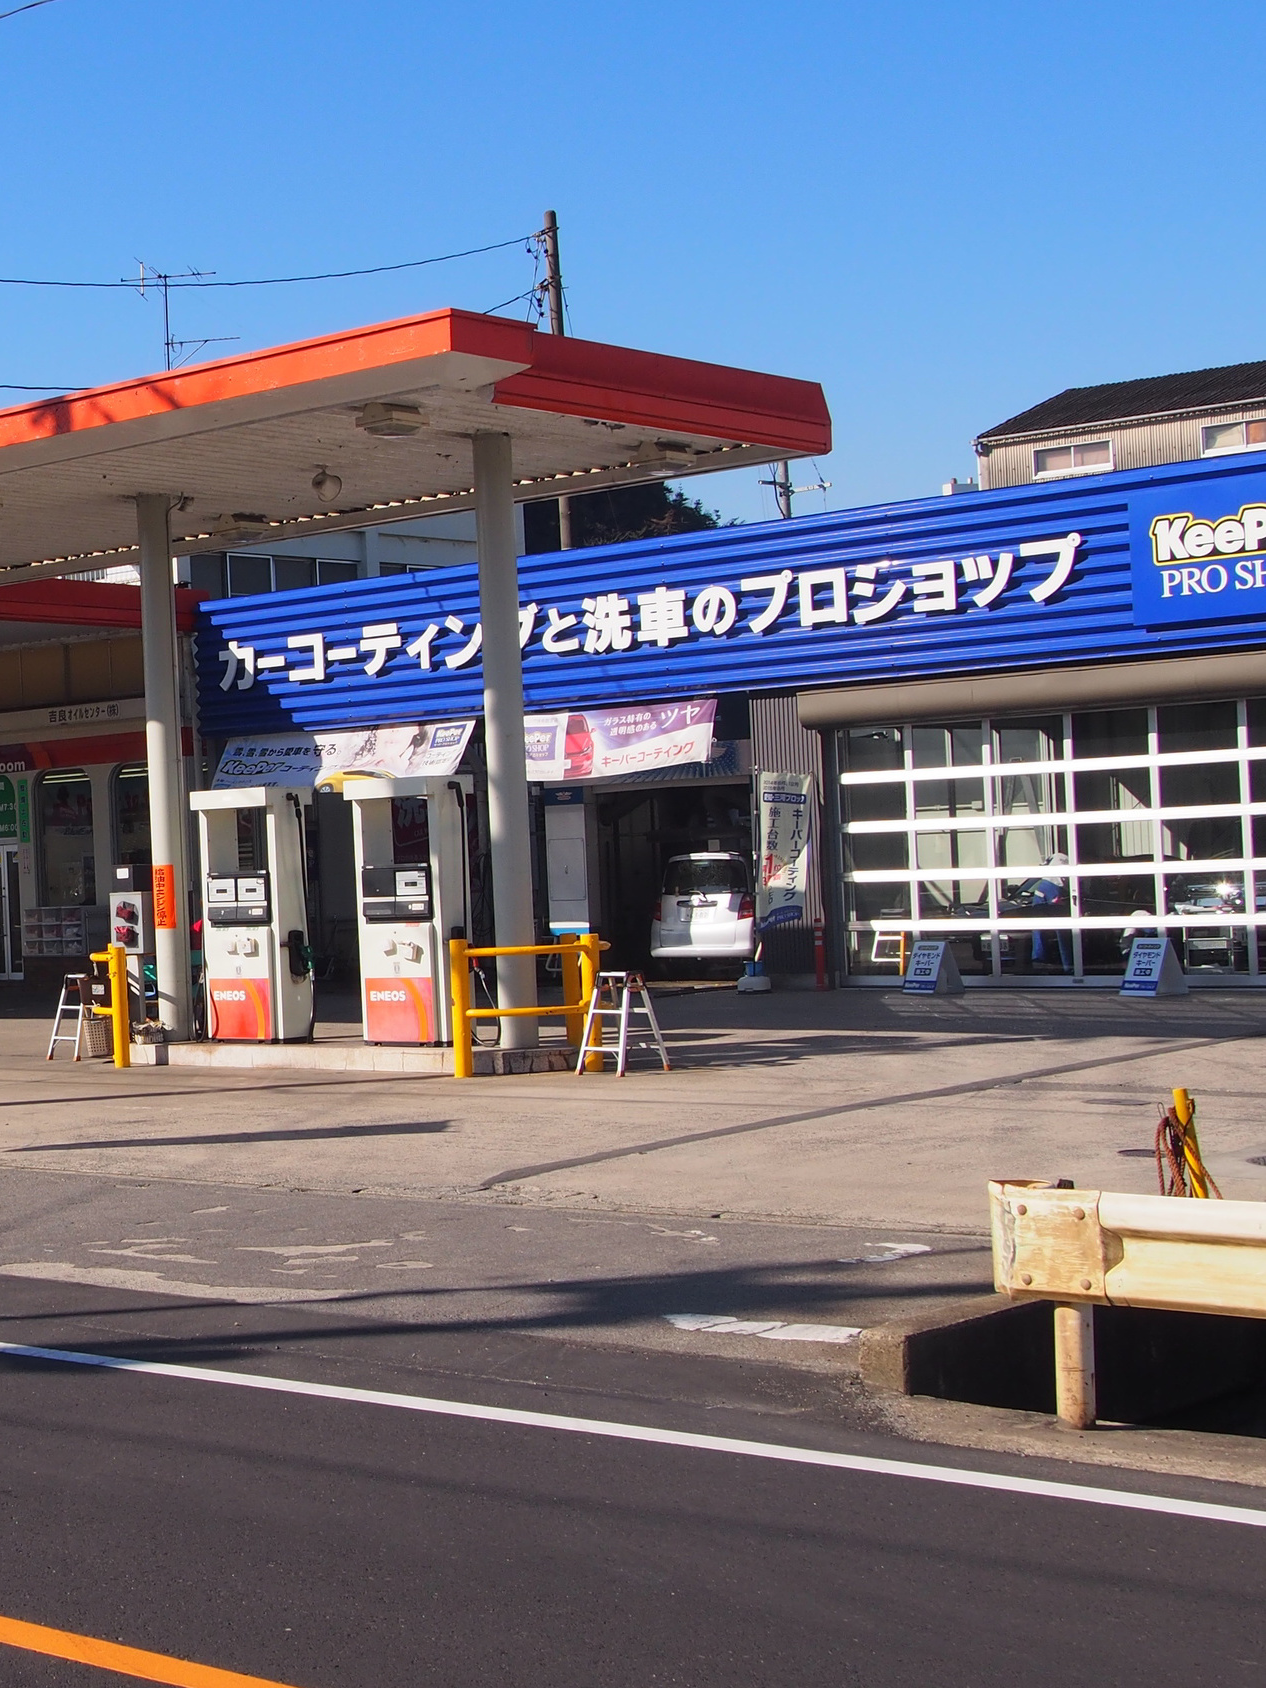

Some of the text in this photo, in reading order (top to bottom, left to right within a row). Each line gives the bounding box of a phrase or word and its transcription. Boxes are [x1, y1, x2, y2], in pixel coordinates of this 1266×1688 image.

[1160, 565, 1228, 598] PRO
[604, 712, 651, 726] ガラス特有の
[661, 704, 701, 728] ツヤ
[610, 722, 657, 736] 透明感のある
[601, 741, 695, 767] キーパーコーティング
[221, 759, 285, 776] KeePer
[766, 807, 781, 850] 施工台数
[1133, 951, 1161, 959] ダイヤモンド
[213, 990, 246, 1001] ENEOS
[370, 990, 406, 1001] ENEOS
